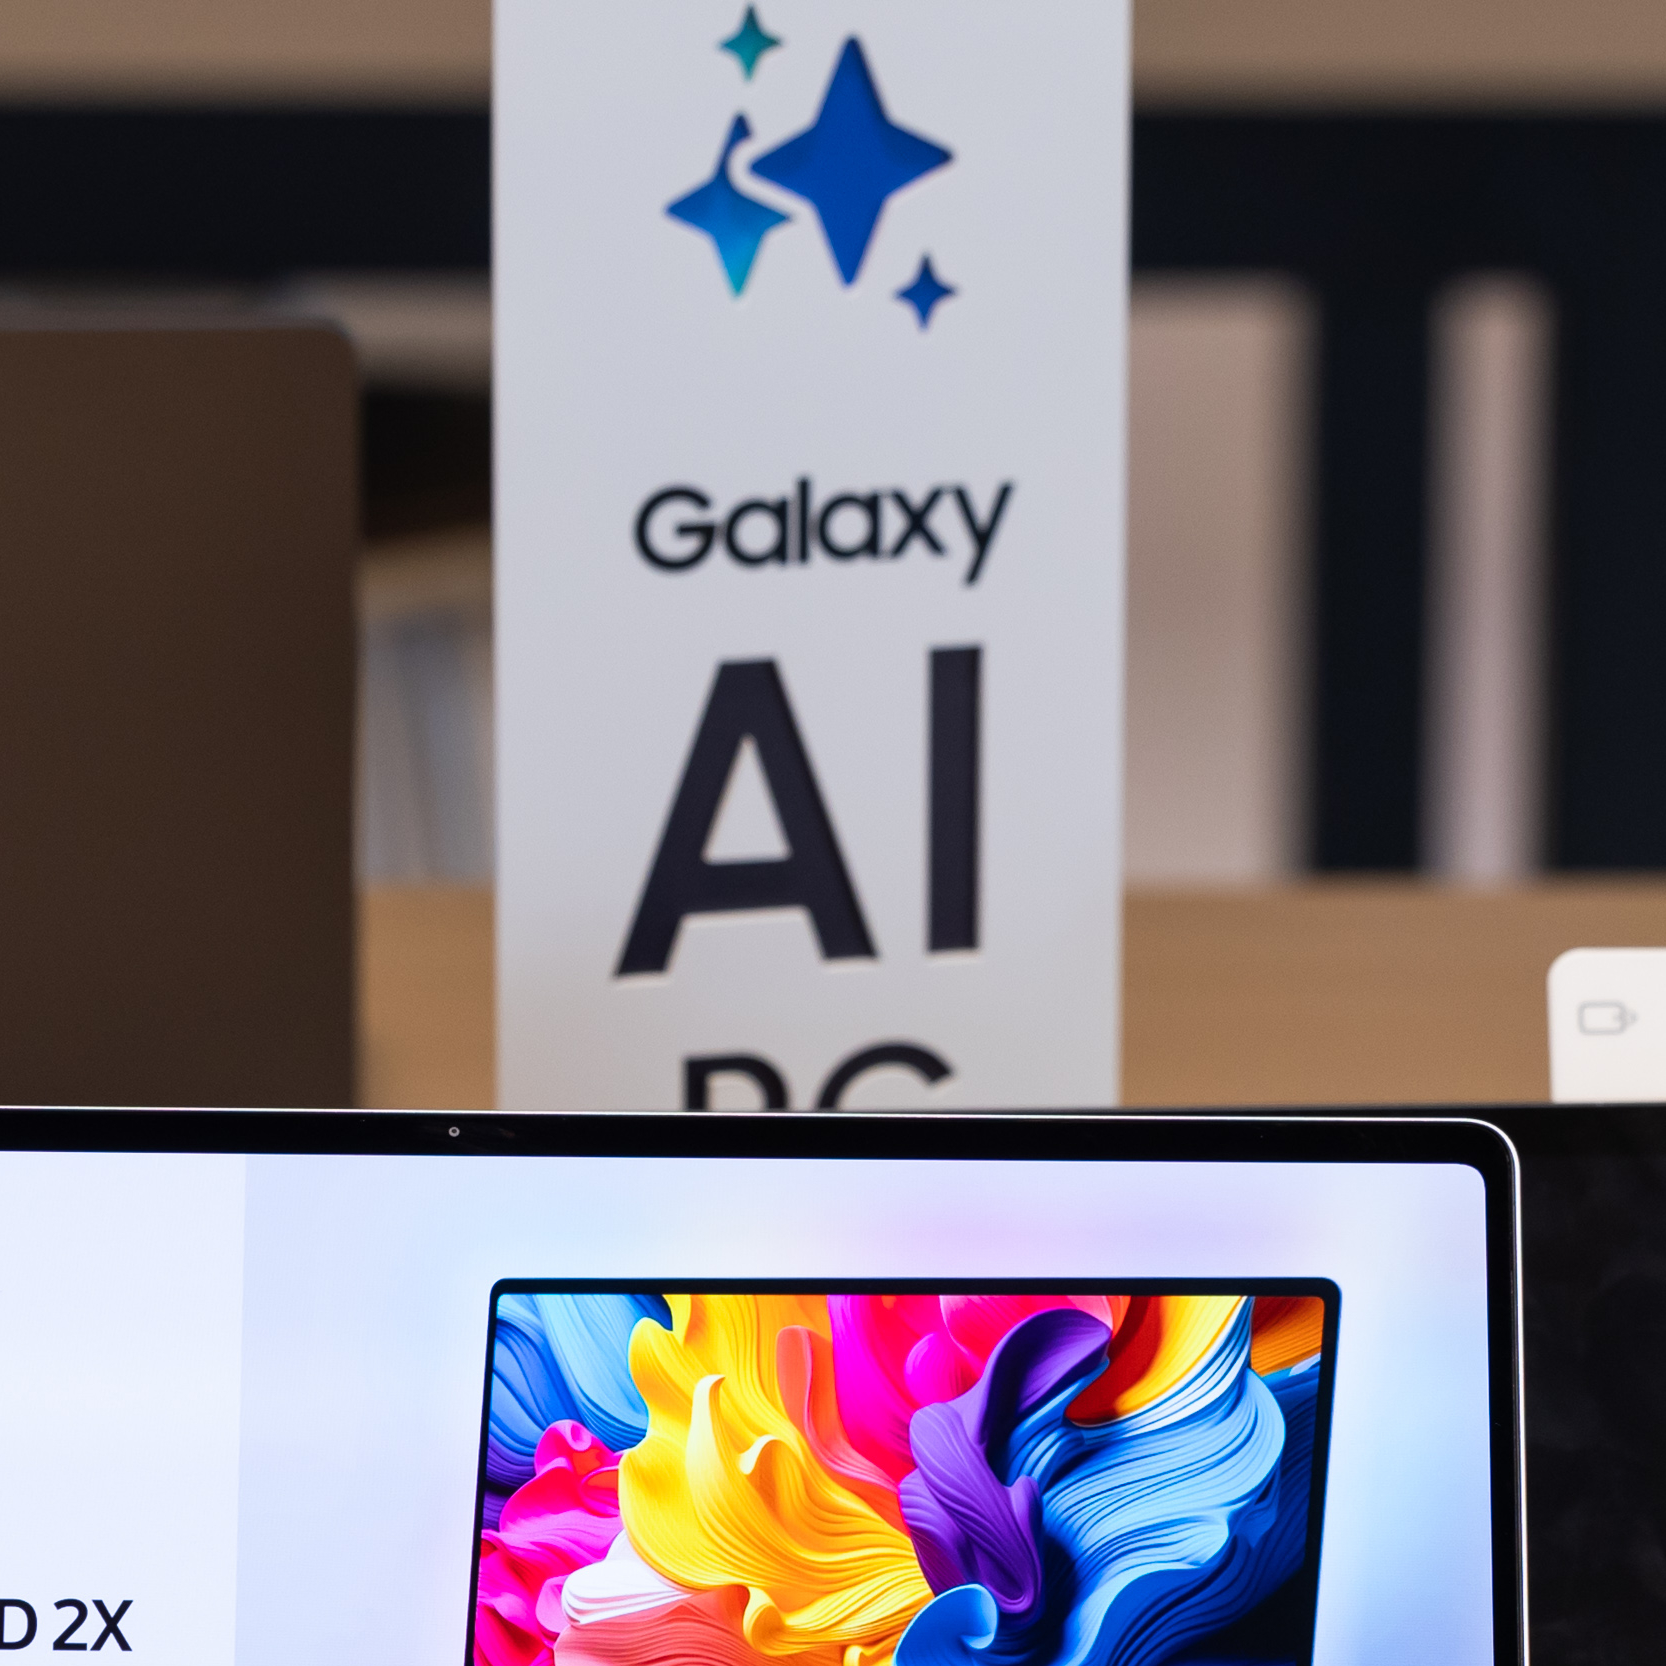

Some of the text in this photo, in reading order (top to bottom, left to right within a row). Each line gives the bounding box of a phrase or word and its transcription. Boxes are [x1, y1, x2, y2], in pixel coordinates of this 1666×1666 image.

[633, 475, 1014, 587] Galaxy
[613, 644, 983, 979] AI
[53, 1598, 133, 1651] 2X
